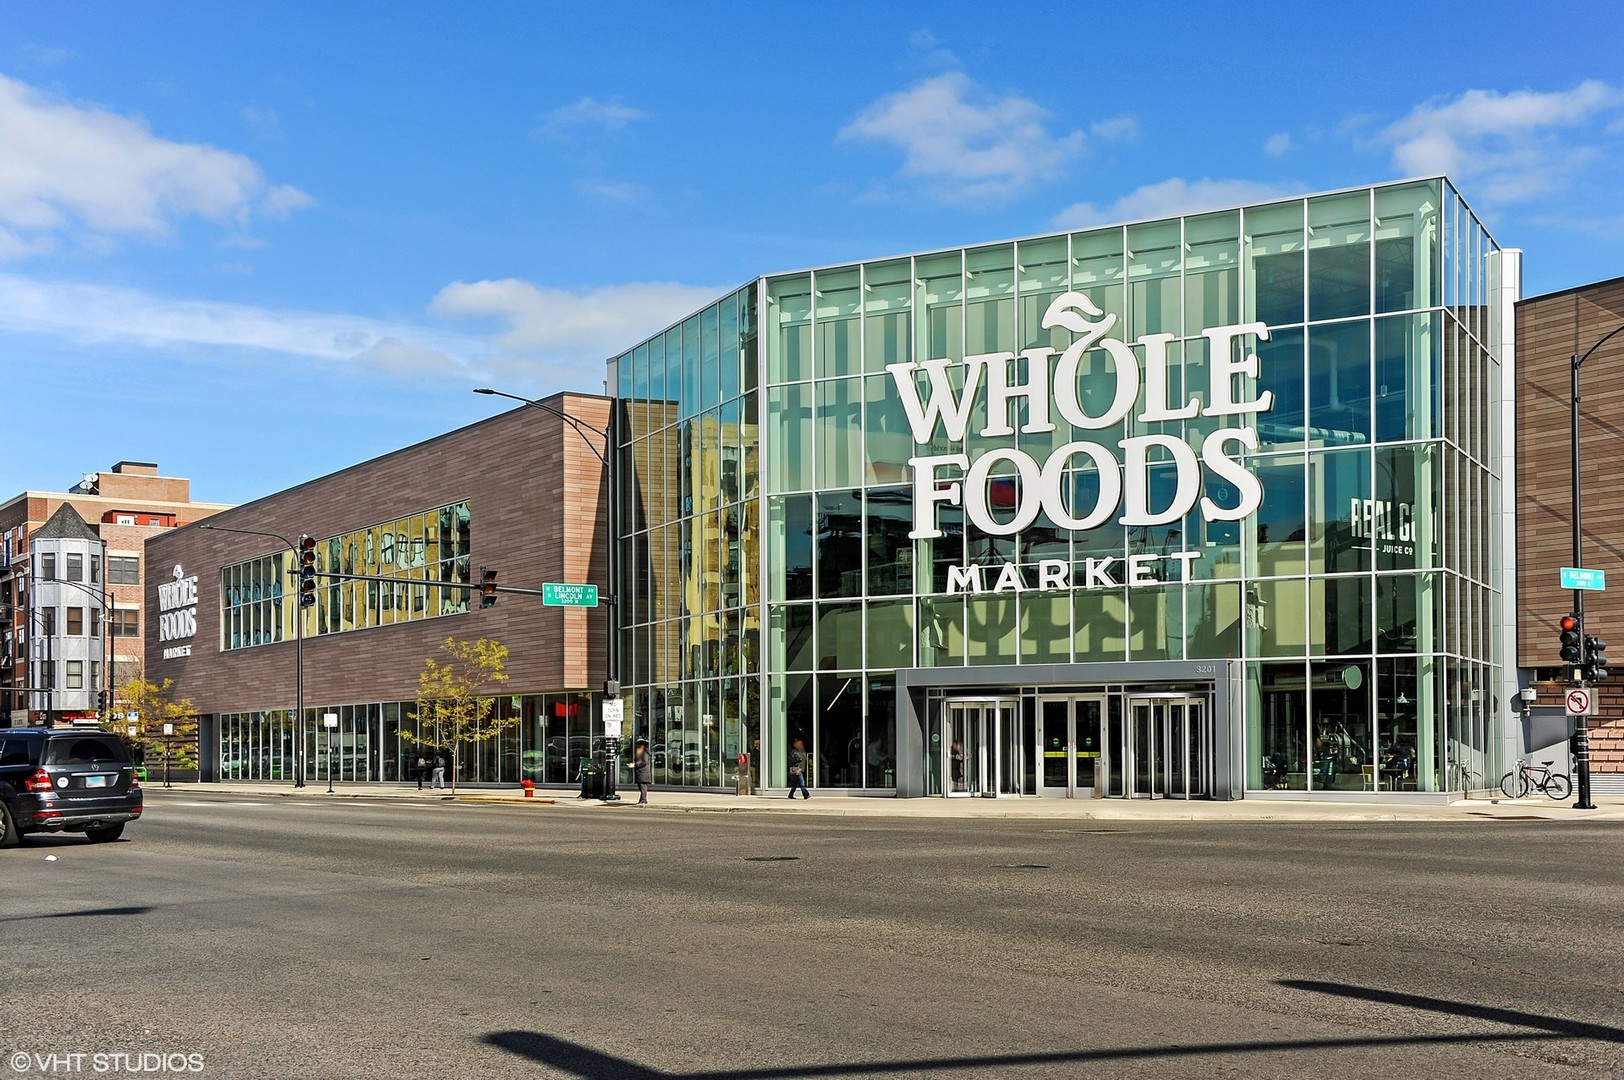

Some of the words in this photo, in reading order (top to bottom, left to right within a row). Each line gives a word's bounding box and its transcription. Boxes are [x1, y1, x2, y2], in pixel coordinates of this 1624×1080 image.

[885, 291, 1274, 444] WHOLE
[908, 427, 1263, 540] FOODS
[1351, 498, 1395, 540] REAL
[1382, 545, 1403, 554] JUICE
[158, 564, 198, 612] WHOLE
[946, 551, 1202, 595] MARKET
[159, 607, 197, 641] FOODS
[163, 645, 192, 659] MARKET
[1196, 665, 1216, 673] 3201
